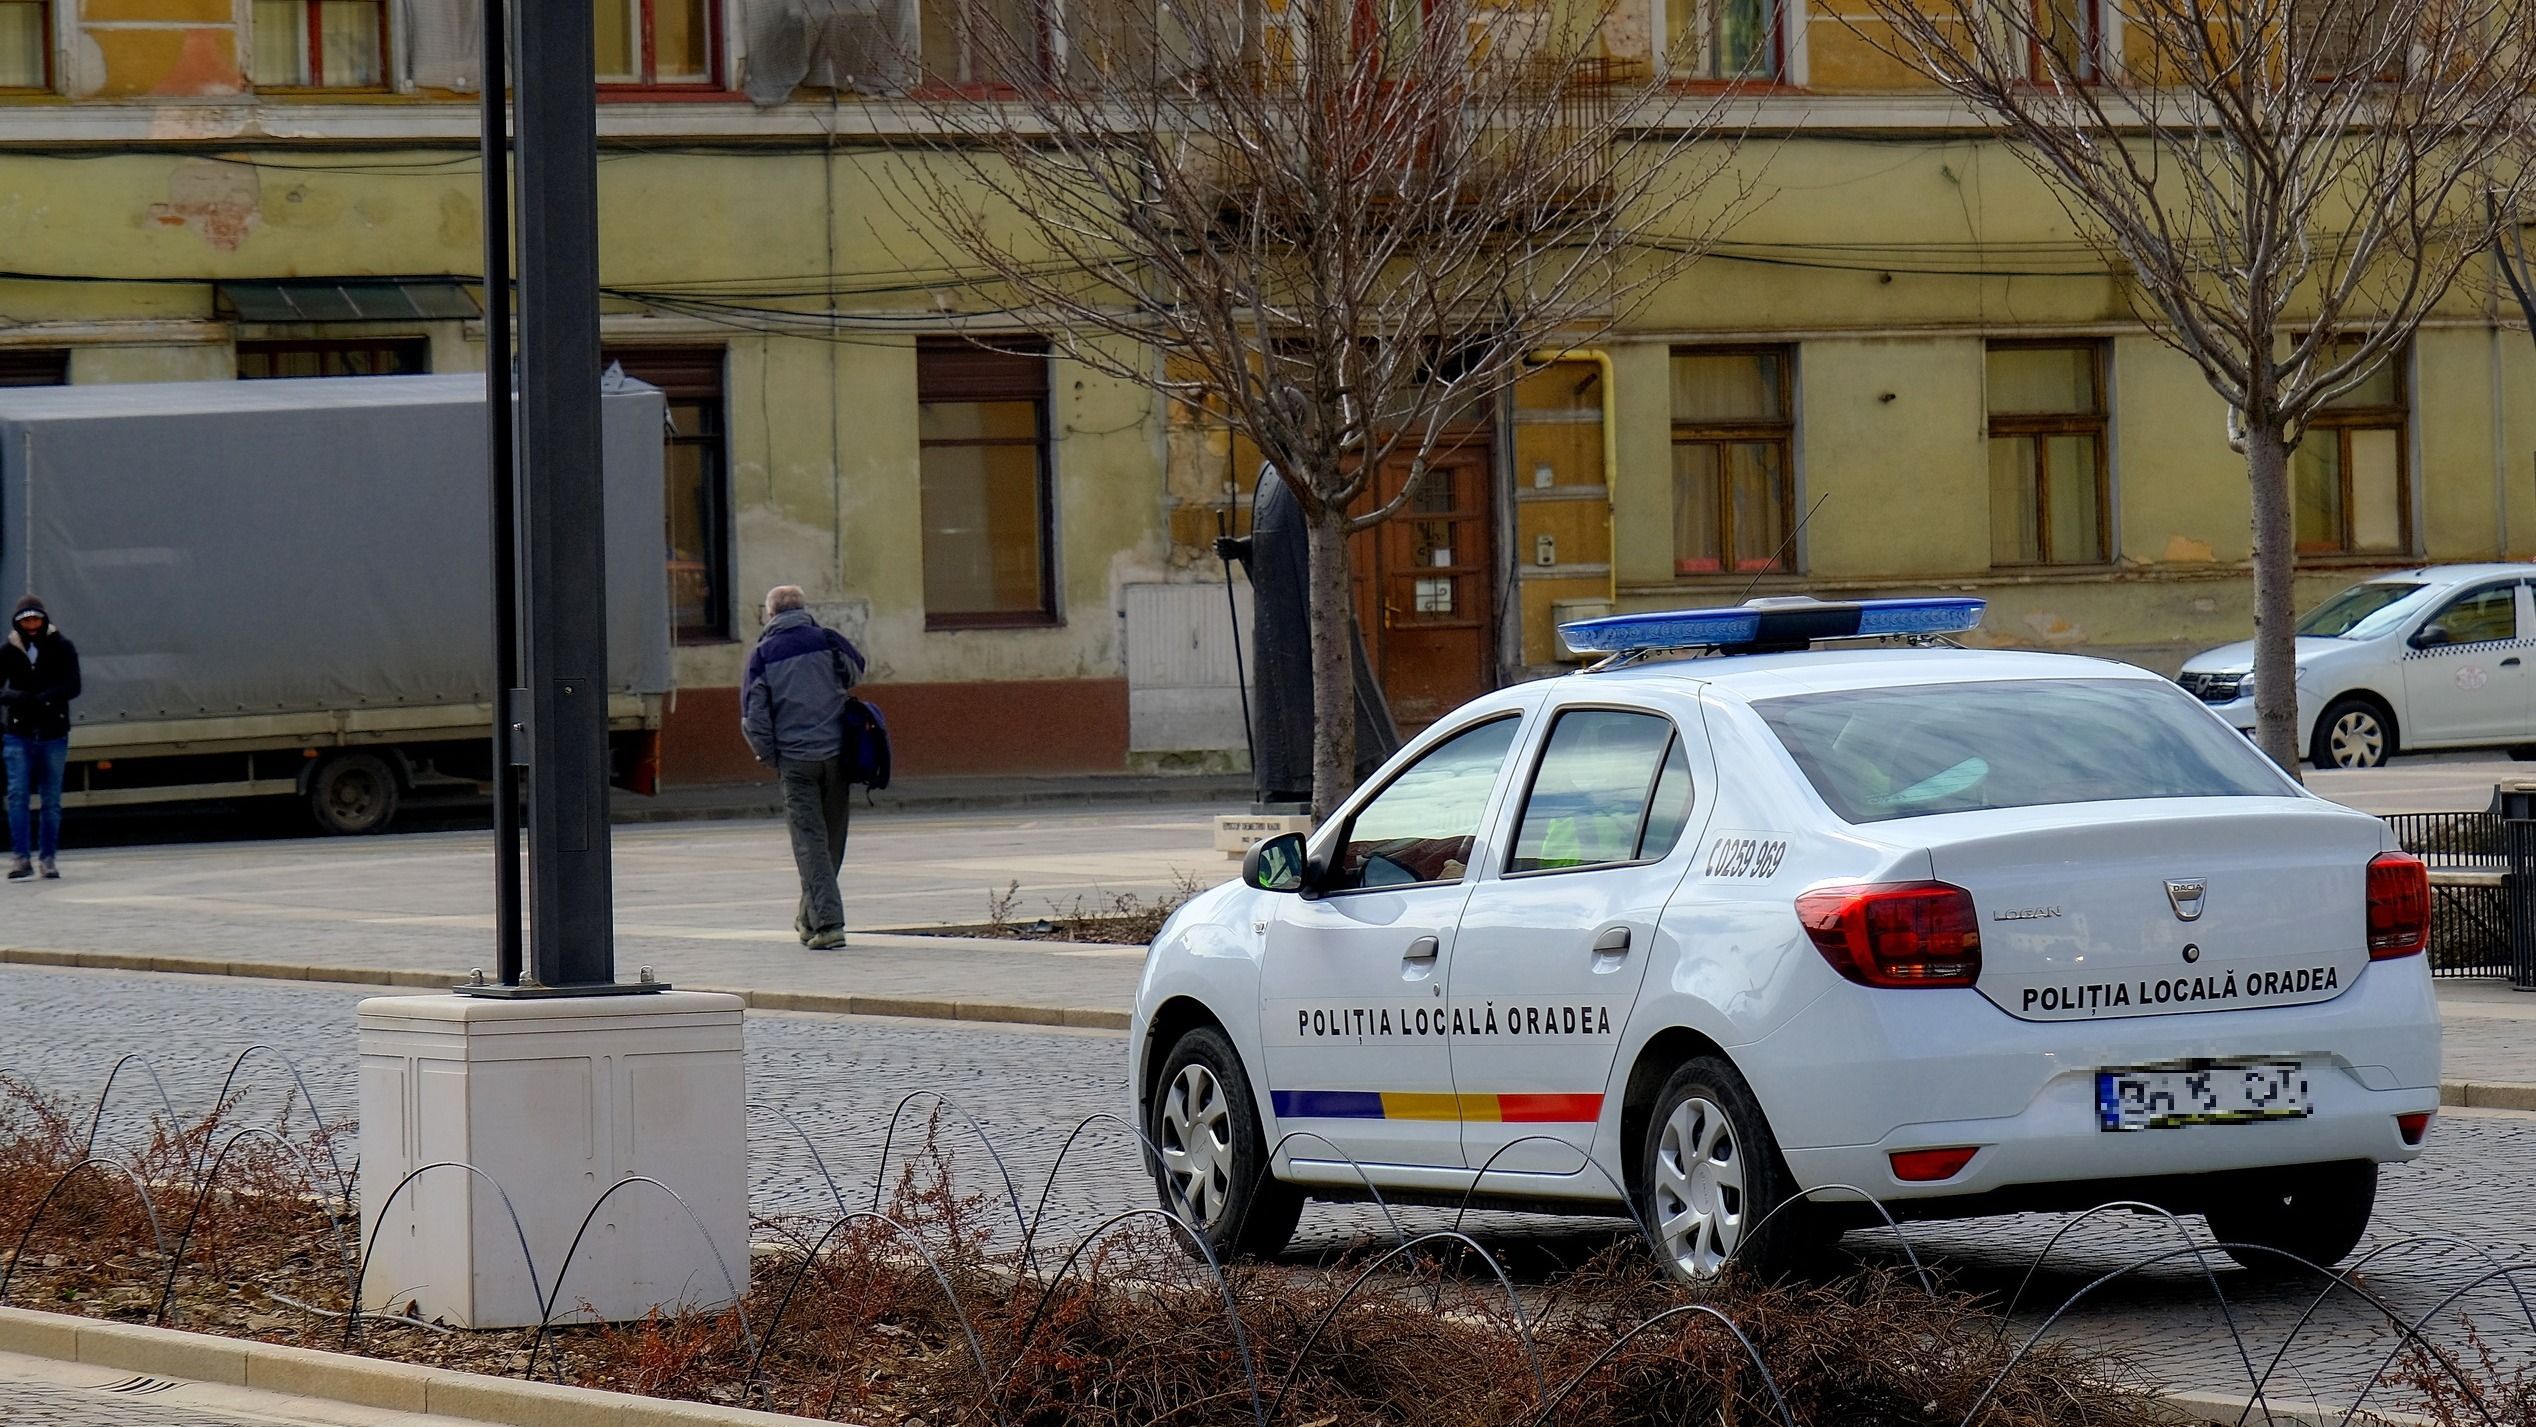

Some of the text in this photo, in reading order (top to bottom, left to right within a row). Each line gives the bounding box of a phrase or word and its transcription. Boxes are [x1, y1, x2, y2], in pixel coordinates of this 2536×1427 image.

[1714, 838, 1787, 879] 0259 969
[2173, 883, 2204, 892] DACIA
[1993, 904, 2062, 922] LOGAN
[2022, 966, 2338, 1016] POLIȚIA LOCALĂ ORADEA
[1298, 1000, 1611, 1046] POLIȚIA LOCALĂ ORADEA
